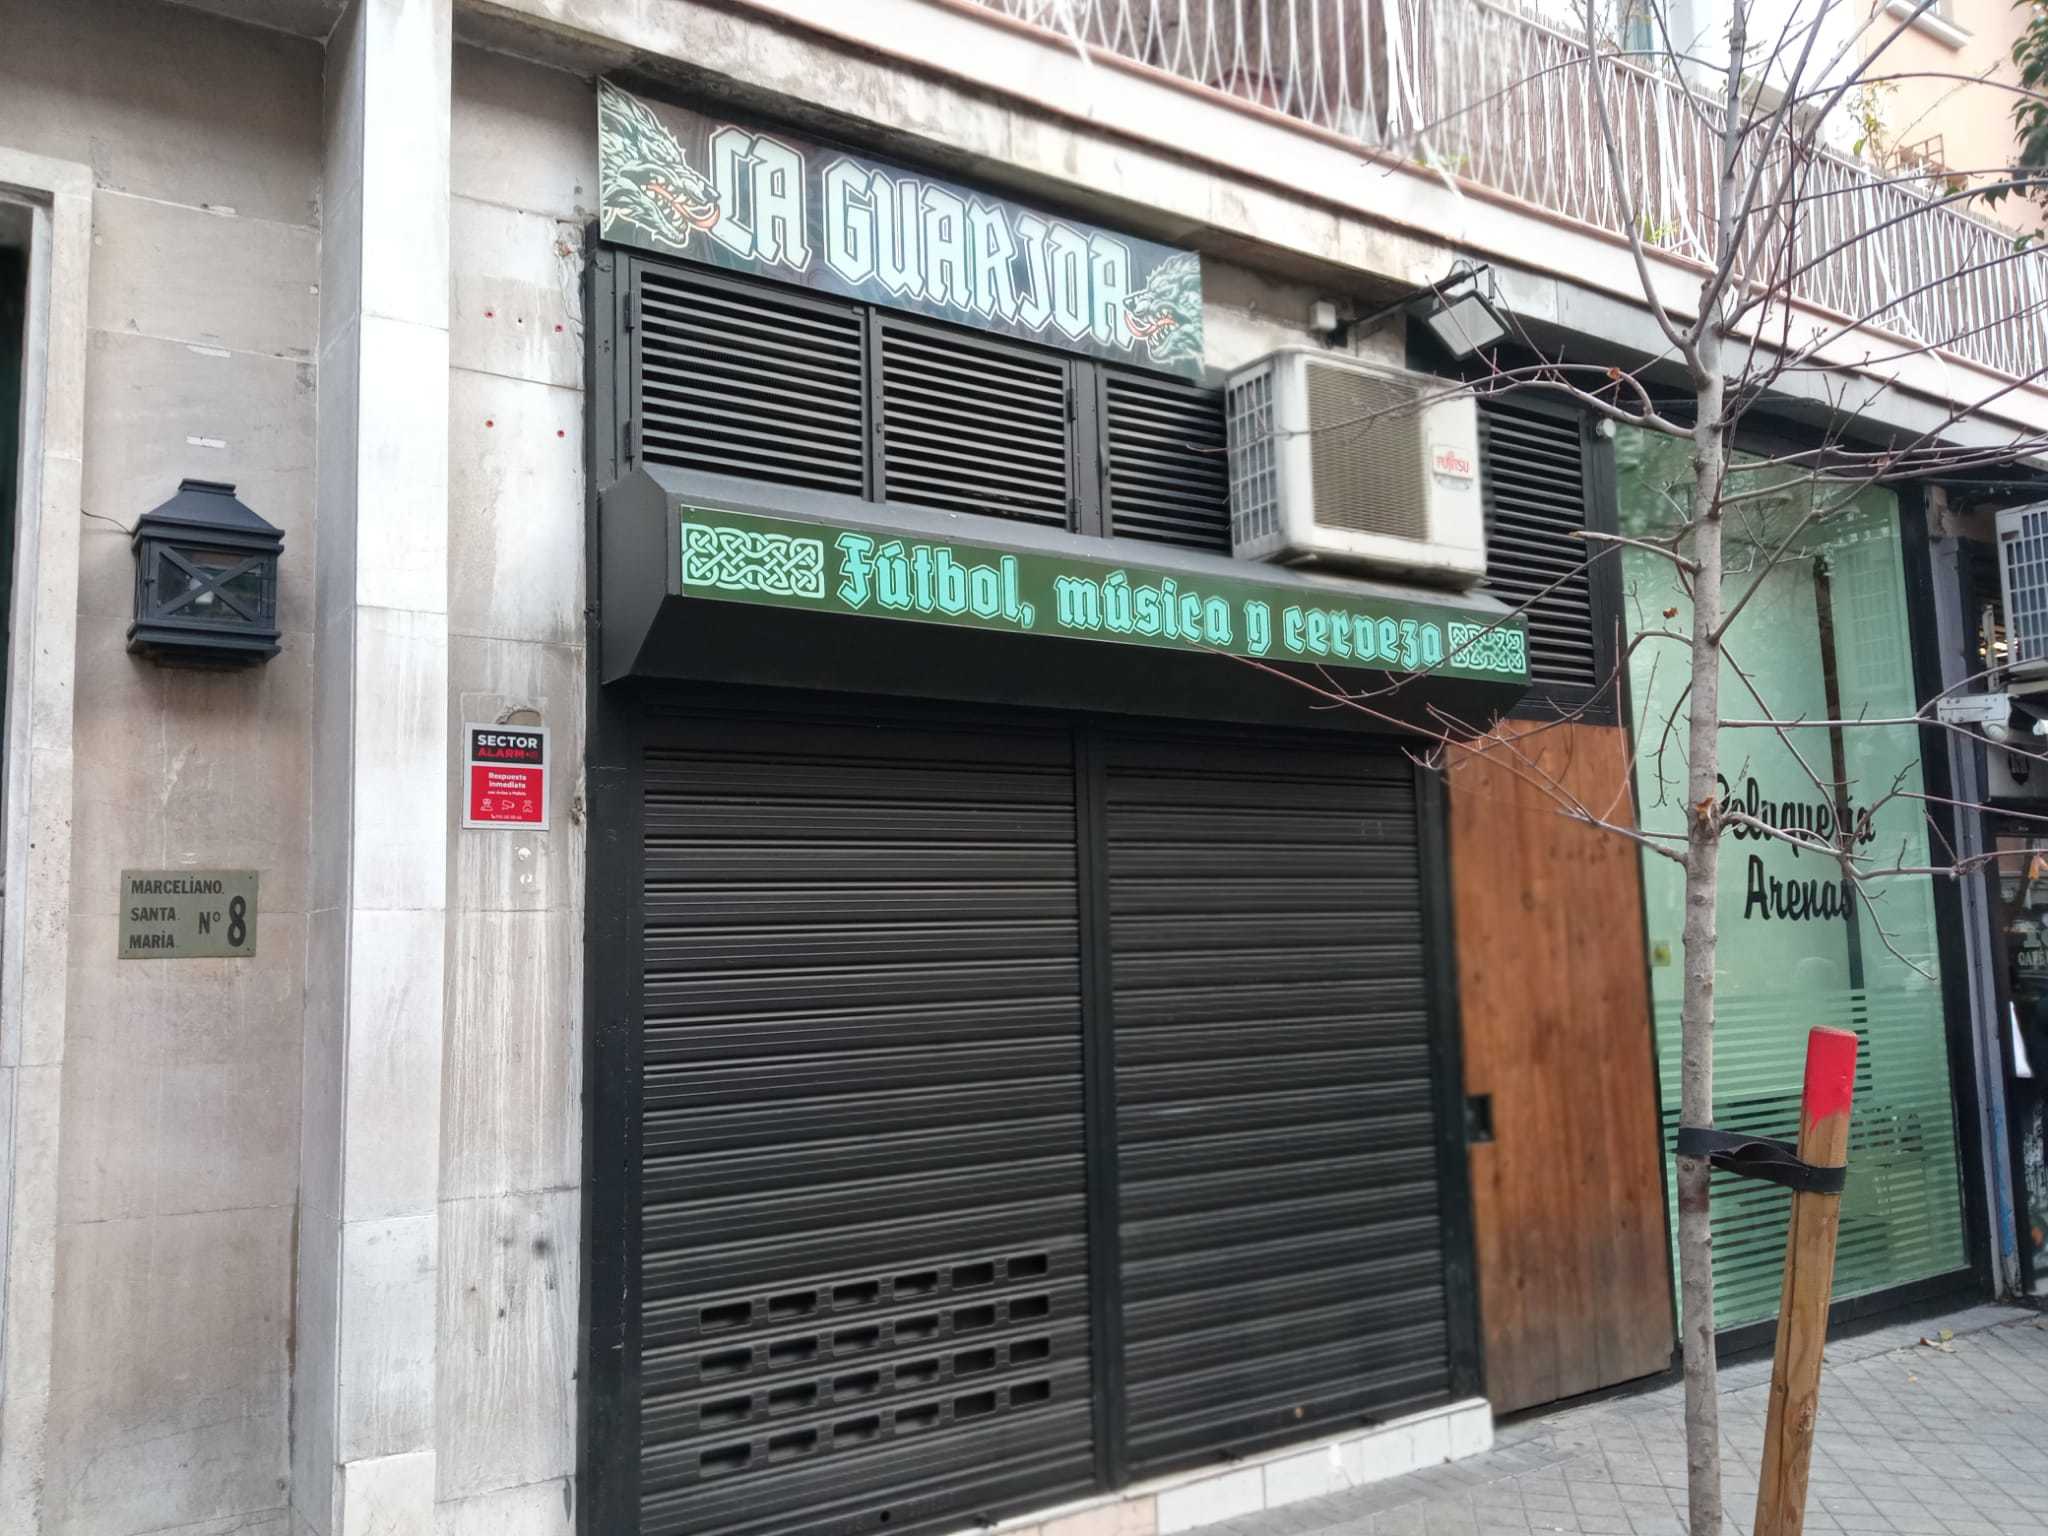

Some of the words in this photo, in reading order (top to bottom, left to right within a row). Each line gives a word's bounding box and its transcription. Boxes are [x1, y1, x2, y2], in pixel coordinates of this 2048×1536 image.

[709, 125, 812, 272] LA
[834, 532, 1035, 629] Fútbol,
[1054, 570, 1233, 646] música
[1243, 600, 1272, 656] y
[1282, 605, 1443, 670] cerveza
[478, 735, 538, 748] SECTOR
[478, 747, 525, 759] ALARM
[1744, 854, 1854, 921] Arenas
[227, 895, 246, 947] 8
